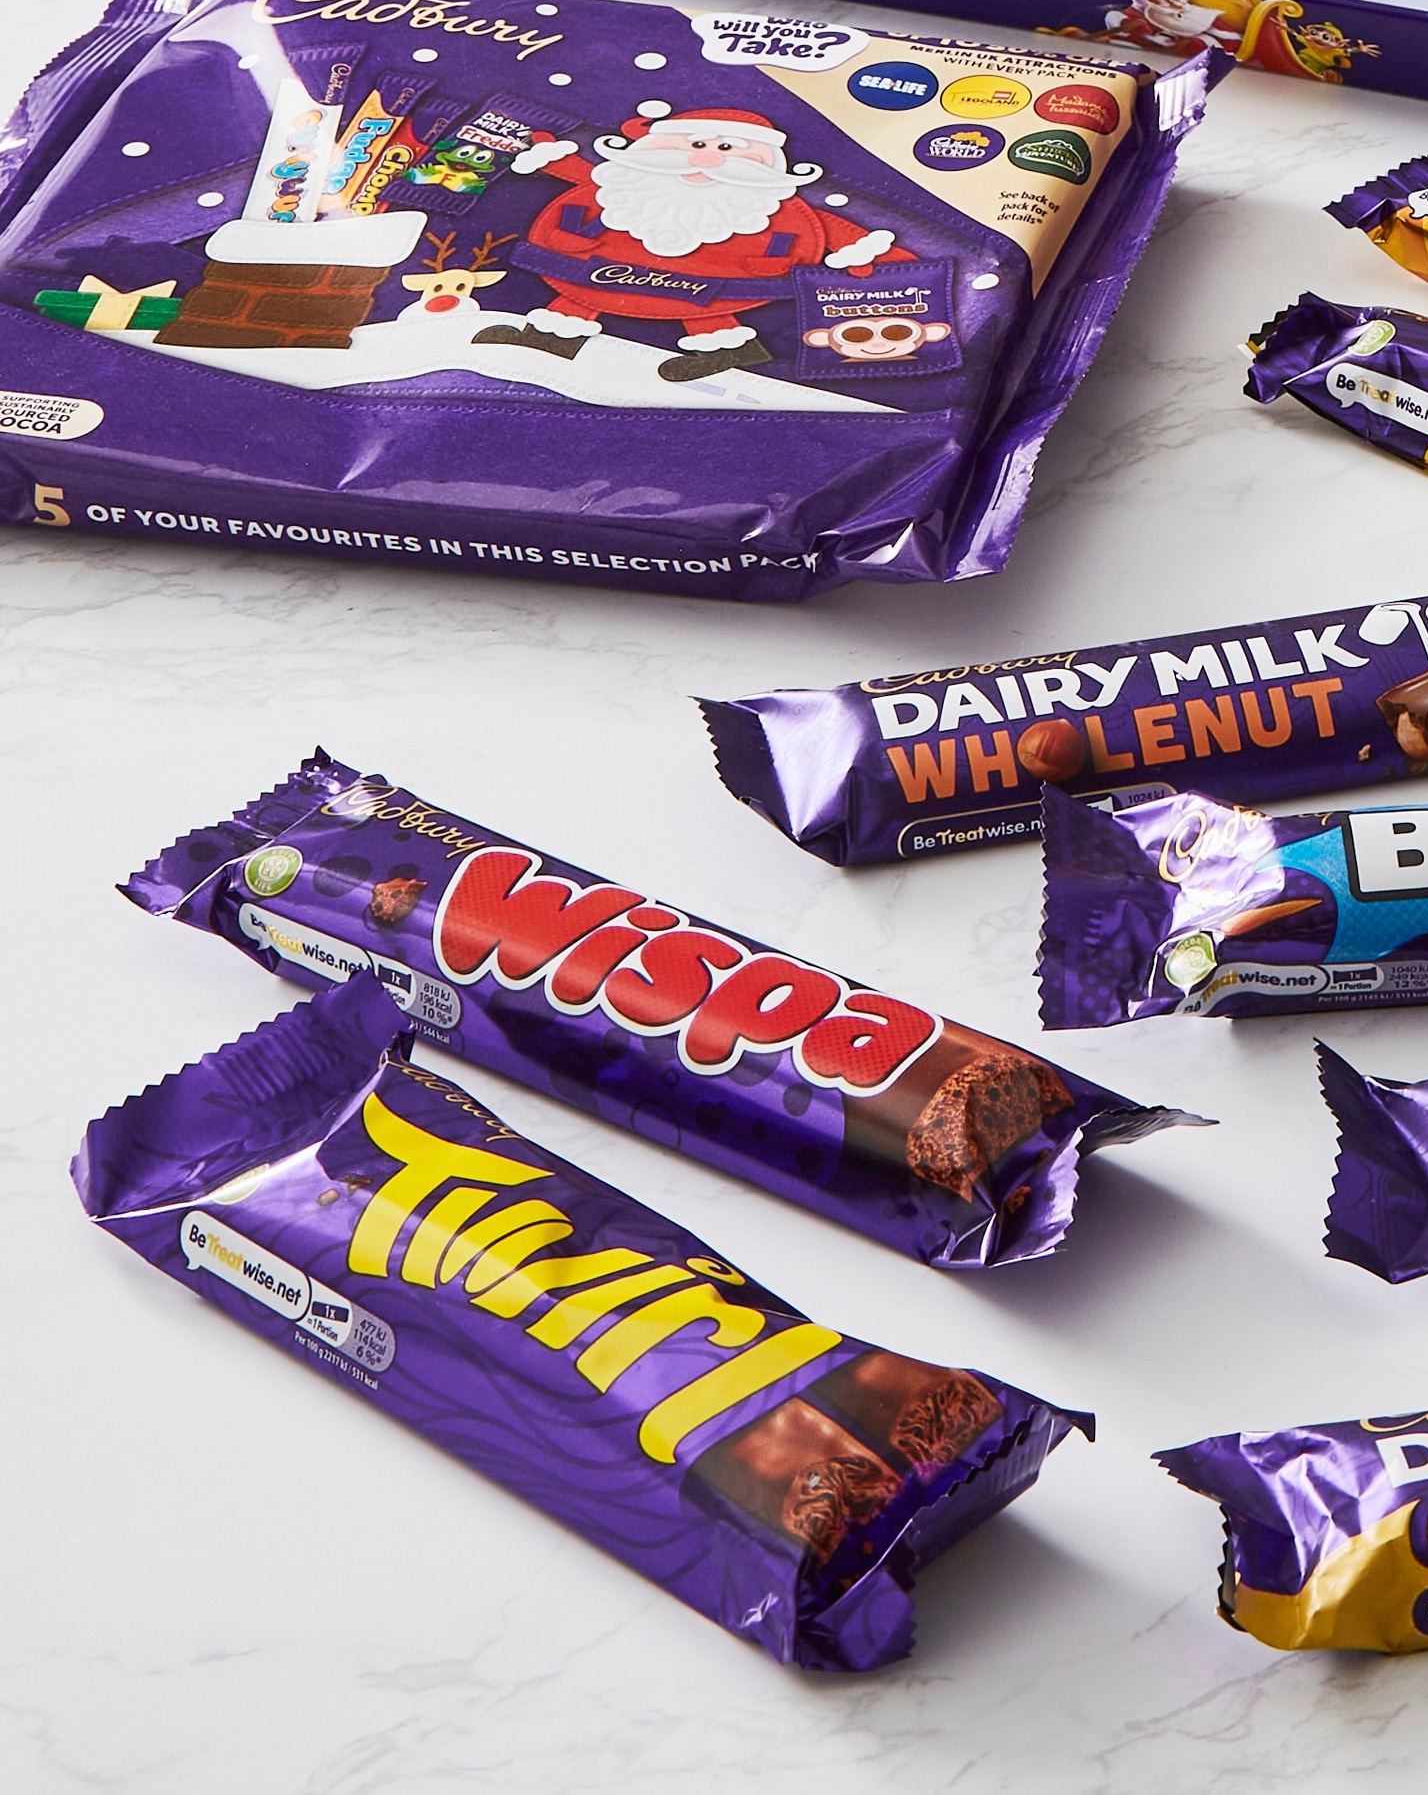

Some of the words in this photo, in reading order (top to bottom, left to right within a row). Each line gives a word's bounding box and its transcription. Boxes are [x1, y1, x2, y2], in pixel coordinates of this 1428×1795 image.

[714, 20, 760, 33] will
[762, 25, 811, 39] you
[718, 31, 852, 58] Take?
[910, 45, 972, 58] MERLIN
[977, 53, 999, 62] UK
[1004, 56, 1118, 79] ATTRACTIONS
[942, 57, 983, 70] WITH
[985, 62, 1033, 77] EVERY
[1037, 68, 1077, 80] PACK
[858, 75, 894, 89] SEA
[960, 94, 1020, 107] LEGOLAND
[929, 145, 986, 159] WORLD
[998, 191, 1020, 200] See
[1021, 191, 1047, 204] back
[1001, 201, 1028, 212] pack
[1030, 203, 1049, 218] for
[590, 265, 708, 295] Cadbury
[817, 291, 865, 302] DAIRY
[866, 290, 905, 301] MILK
[826, 304, 927, 318] buttons
[1, 395, 80, 409] SUPPORTING
[33, 483, 71, 527] 5
[86, 504, 127, 524] OF
[134, 509, 220, 534] YOUR
[227, 520, 422, 554] FAVOURITES
[429, 538, 463, 556] IN
[470, 542, 544, 563] THIS
[550, 549, 732, 575] SELECTION
[741, 552, 820, 575] PACK
[870, 654, 1138, 741] DAIRY
[1150, 623, 1370, 697] MILK
[319, 783, 486, 861] Cadbury
[438, 849, 938, 1088] Wispa
[347, 1091, 844, 1466] Twirl
[325, 1305, 336, 1320] 1x
[317, 1321, 338, 1342] Portion
[359, 1319, 377, 1335] 477
